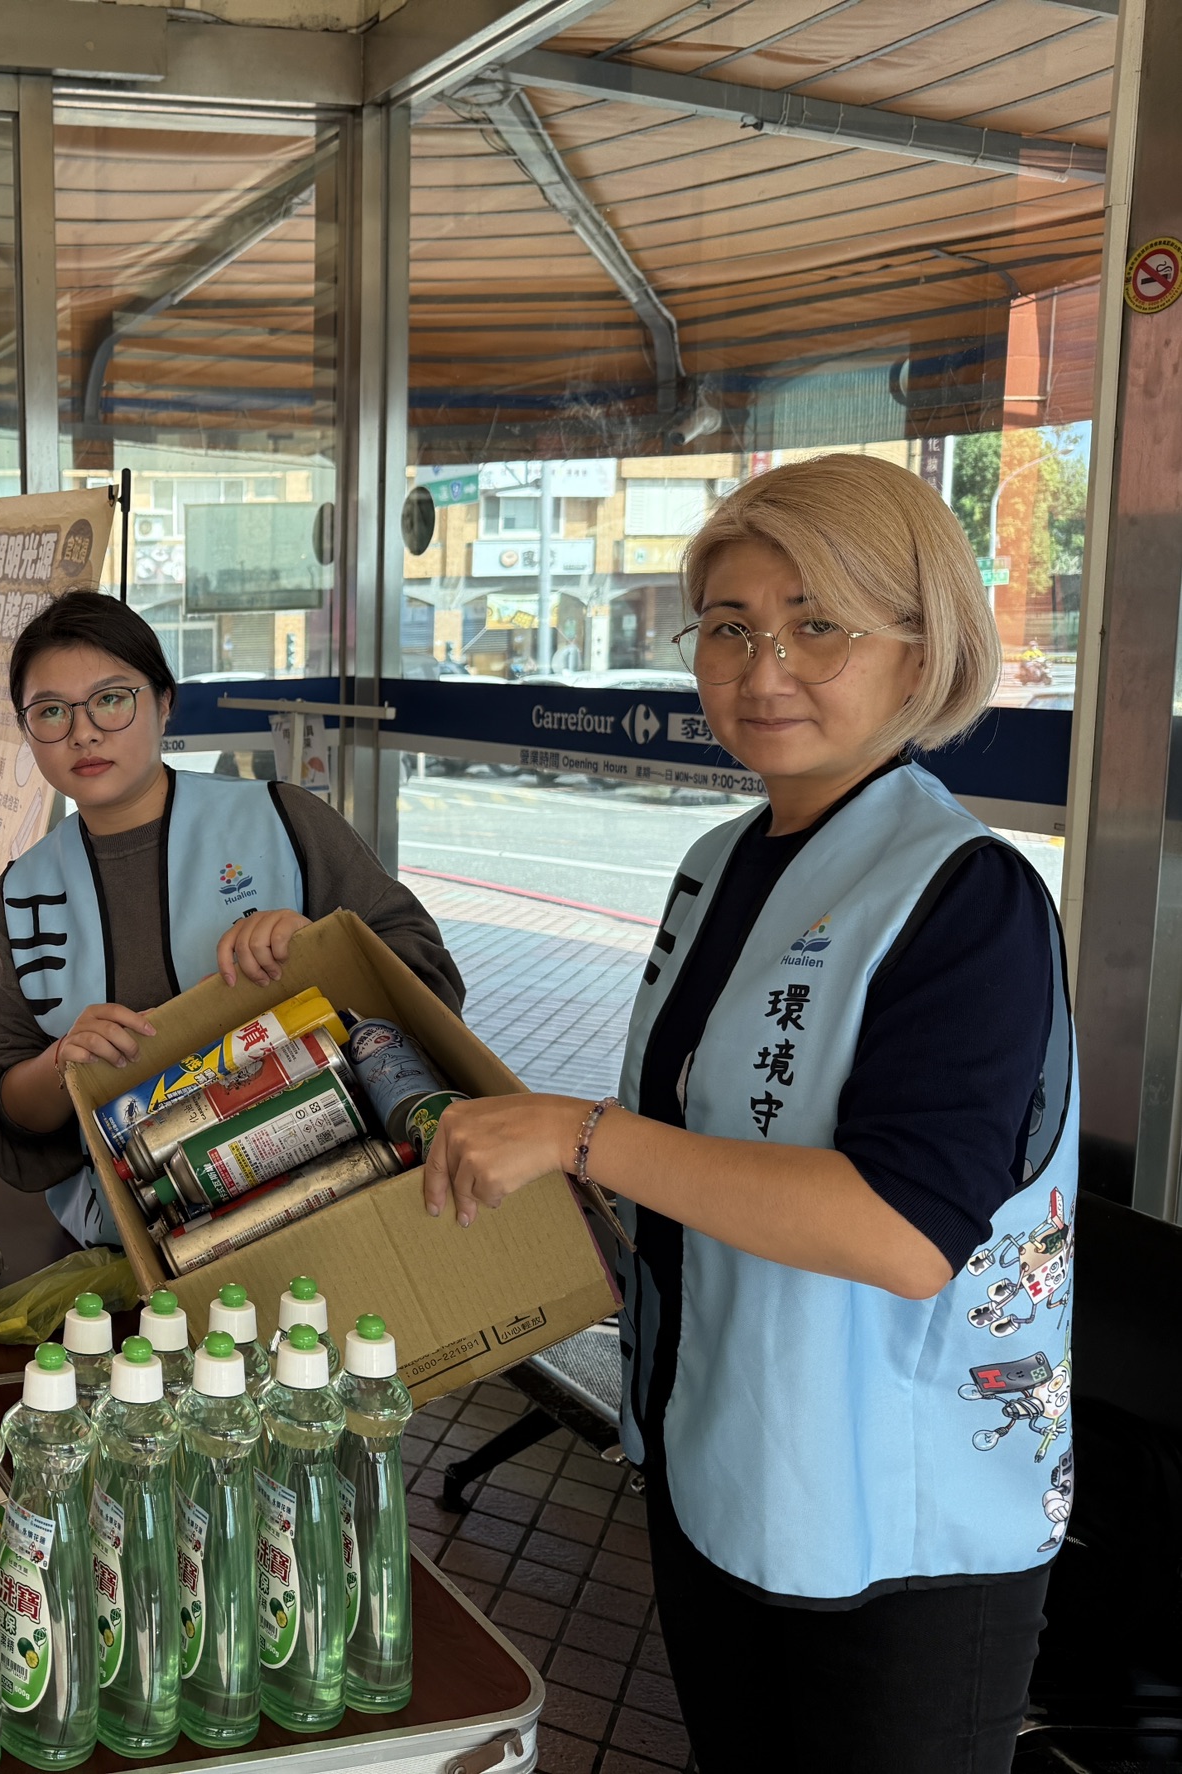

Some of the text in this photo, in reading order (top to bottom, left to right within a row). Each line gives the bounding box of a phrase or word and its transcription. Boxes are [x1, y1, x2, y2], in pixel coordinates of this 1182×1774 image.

[531, 704, 615, 734] Carrefour
[160, 739, 185, 751] 3:00
[520, 749, 560, 769] 營業時間
[562, 757, 598, 773] Opening
[603, 760, 628, 775] Hours
[712, 773, 767, 794] 9:00~23:0
[224, 887, 257, 906] Hualien
[780, 954, 824, 969] Hualien
[750, 983, 811, 1138] 環境守
[501, 1315, 543, 1341] 小心輕放
[93, 1553, 119, 1605] 寶
